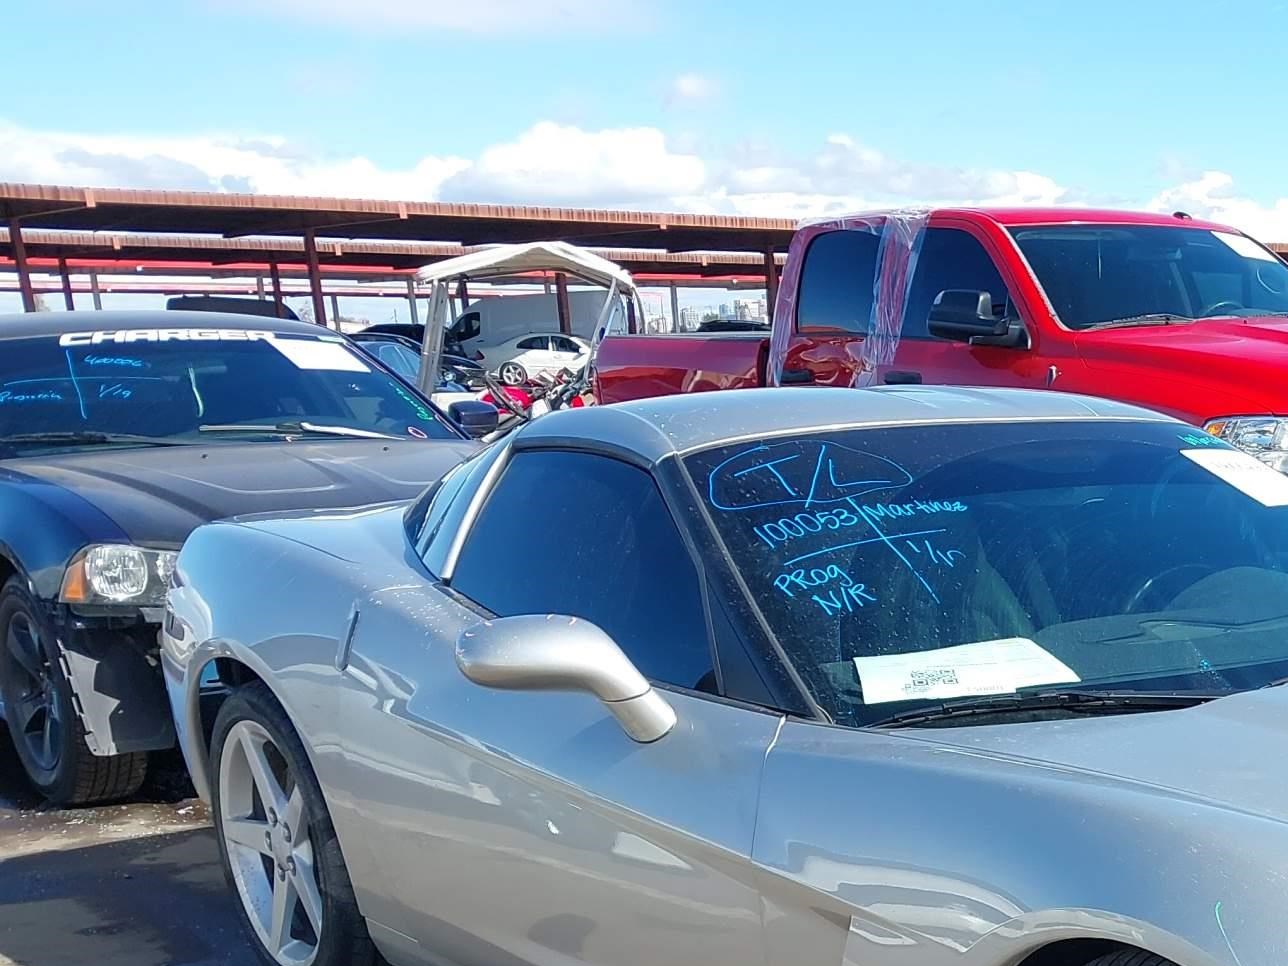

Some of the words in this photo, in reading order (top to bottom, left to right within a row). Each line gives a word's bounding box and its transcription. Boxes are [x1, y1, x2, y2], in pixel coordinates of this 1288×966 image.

[59, 329, 275, 347] CHARGER
[861, 496, 968, 521] Martinez
[753, 509, 858, 549] 100053
